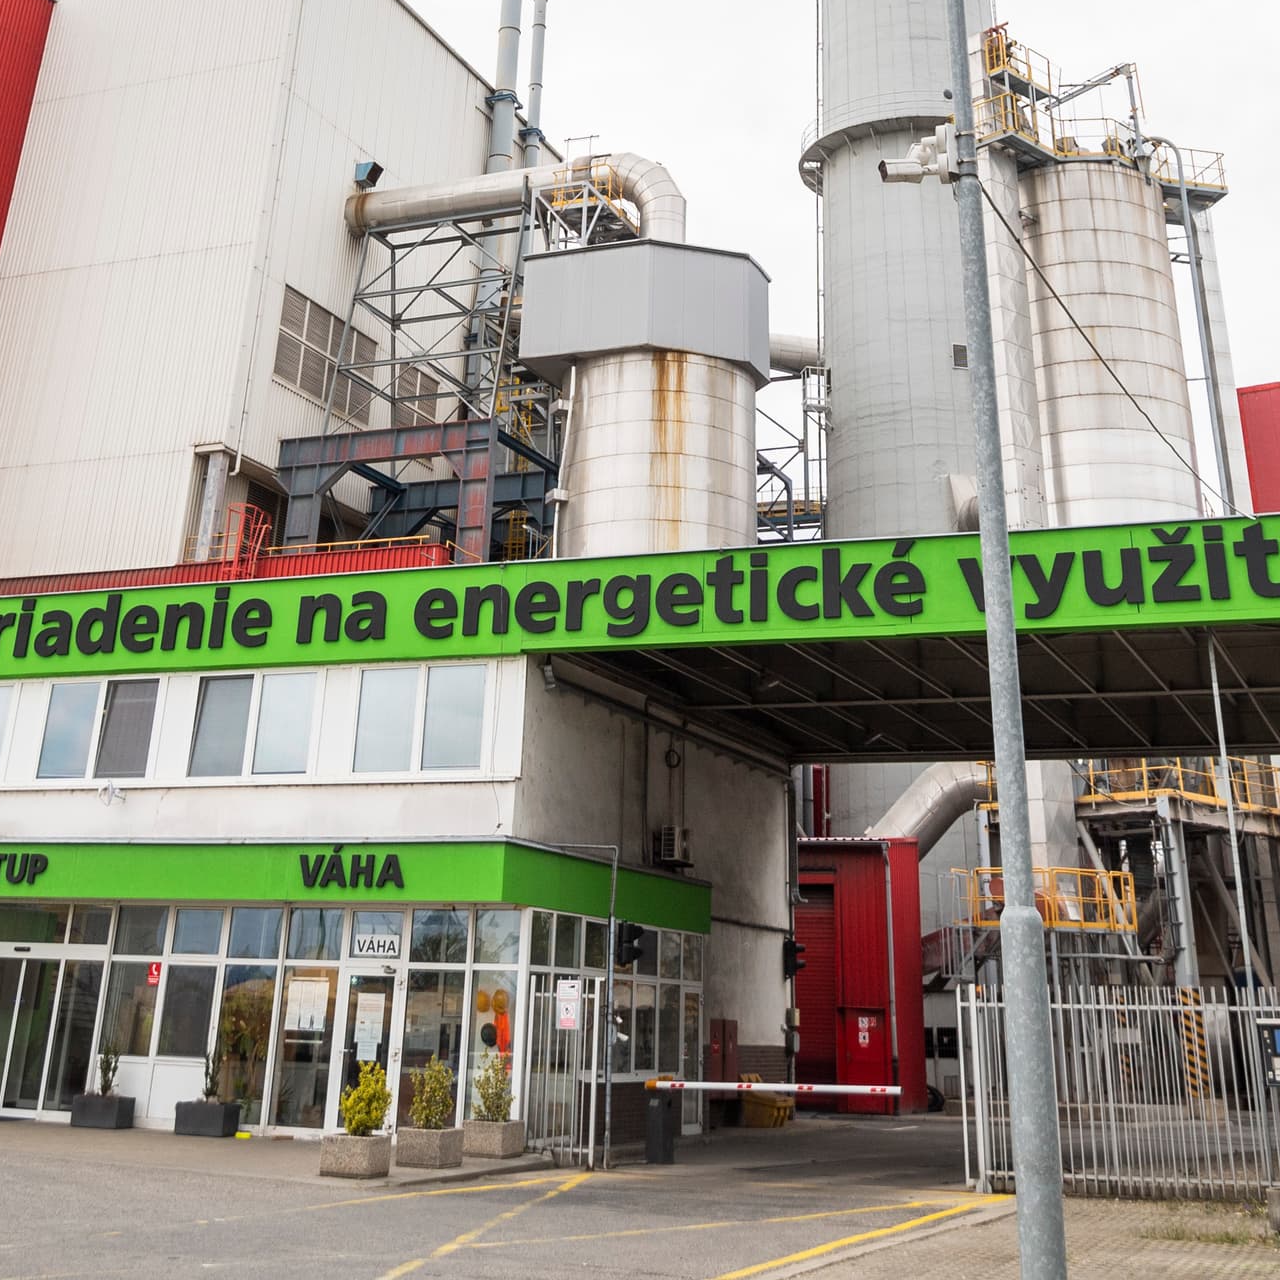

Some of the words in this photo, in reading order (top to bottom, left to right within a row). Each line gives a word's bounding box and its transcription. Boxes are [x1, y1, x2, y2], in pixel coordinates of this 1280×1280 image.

[295, 588, 388, 645] na
[414, 540, 927, 639] energetické
[299, 845, 406, 889] VÁHA
[357, 935, 397, 954] VÁHA
